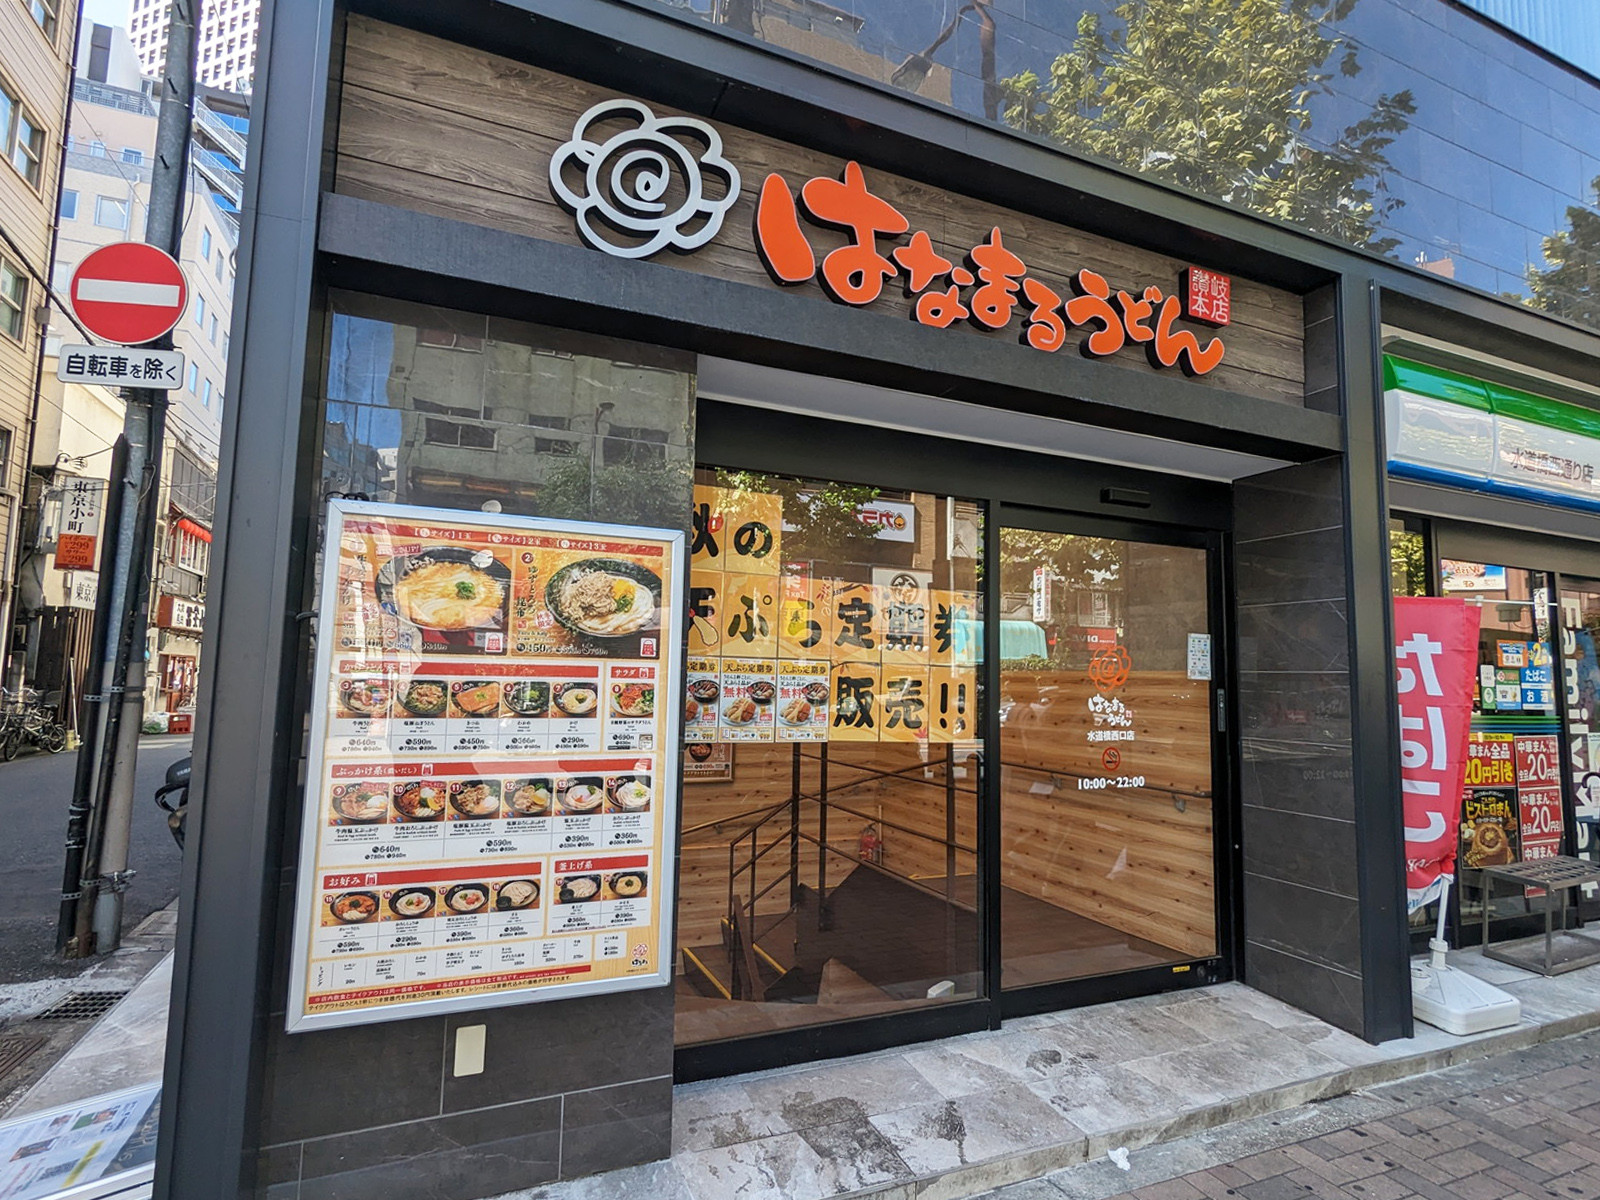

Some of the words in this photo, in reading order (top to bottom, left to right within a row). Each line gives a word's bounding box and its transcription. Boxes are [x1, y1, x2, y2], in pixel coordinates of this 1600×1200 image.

[756, 160, 1225, 375] はなまるうどん
[66, 353, 177, 381] 自転車を除く
[67, 480, 88, 533] 東京小町
[614, 668, 636, 678] サラダ
[725, 662, 773, 673] 天ぷら定期券
[780, 664, 827, 674] 天ぷら定期券
[1525, 669, 1547, 682] たばこ
[1087, 730, 1135, 741] 水道橋西口店
[1517, 741, 1547, 754] 中華まん
[1464, 759, 1513, 785] 20円引き
[1521, 793, 1550, 806] 中華まん
[1466, 800, 1512, 820] ビストロまん
[1525, 846, 1555, 860] 中華まん
[559, 860, 594, 871] 釜上げ系
[328, 877, 361, 887] お好み
